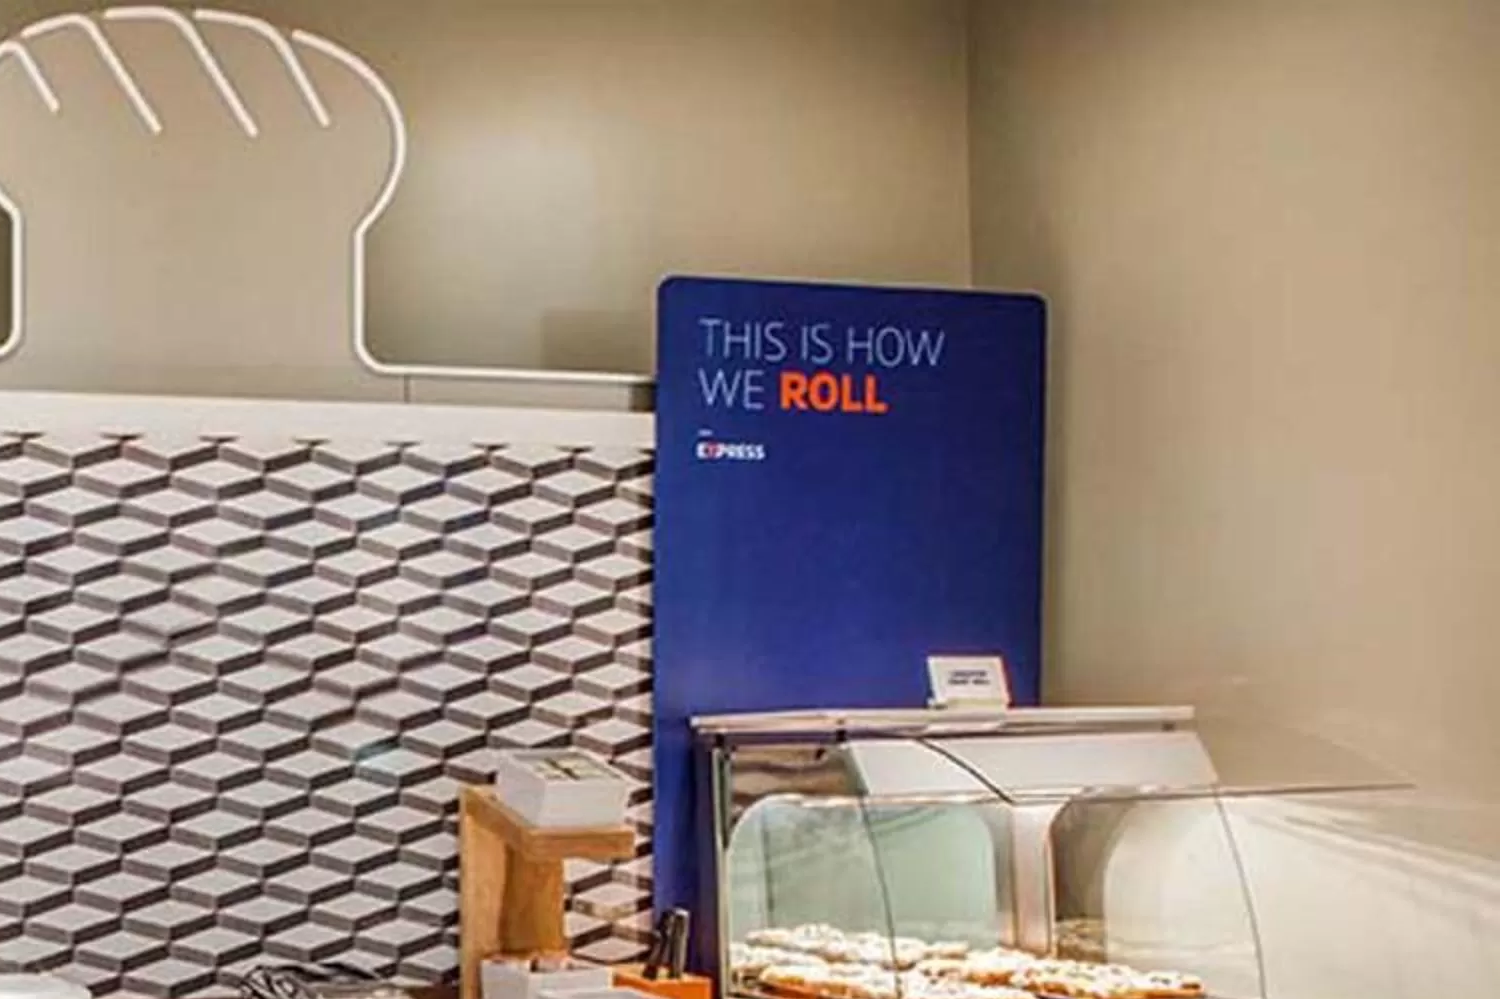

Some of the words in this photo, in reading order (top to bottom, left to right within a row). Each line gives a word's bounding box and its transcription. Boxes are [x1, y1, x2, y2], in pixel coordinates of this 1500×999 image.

[698, 318, 788, 363] THIS
[799, 325, 833, 365] IS
[847, 327, 945, 368] HOW
[698, 368, 765, 410] WE
[779, 371, 889, 414] ROLL
